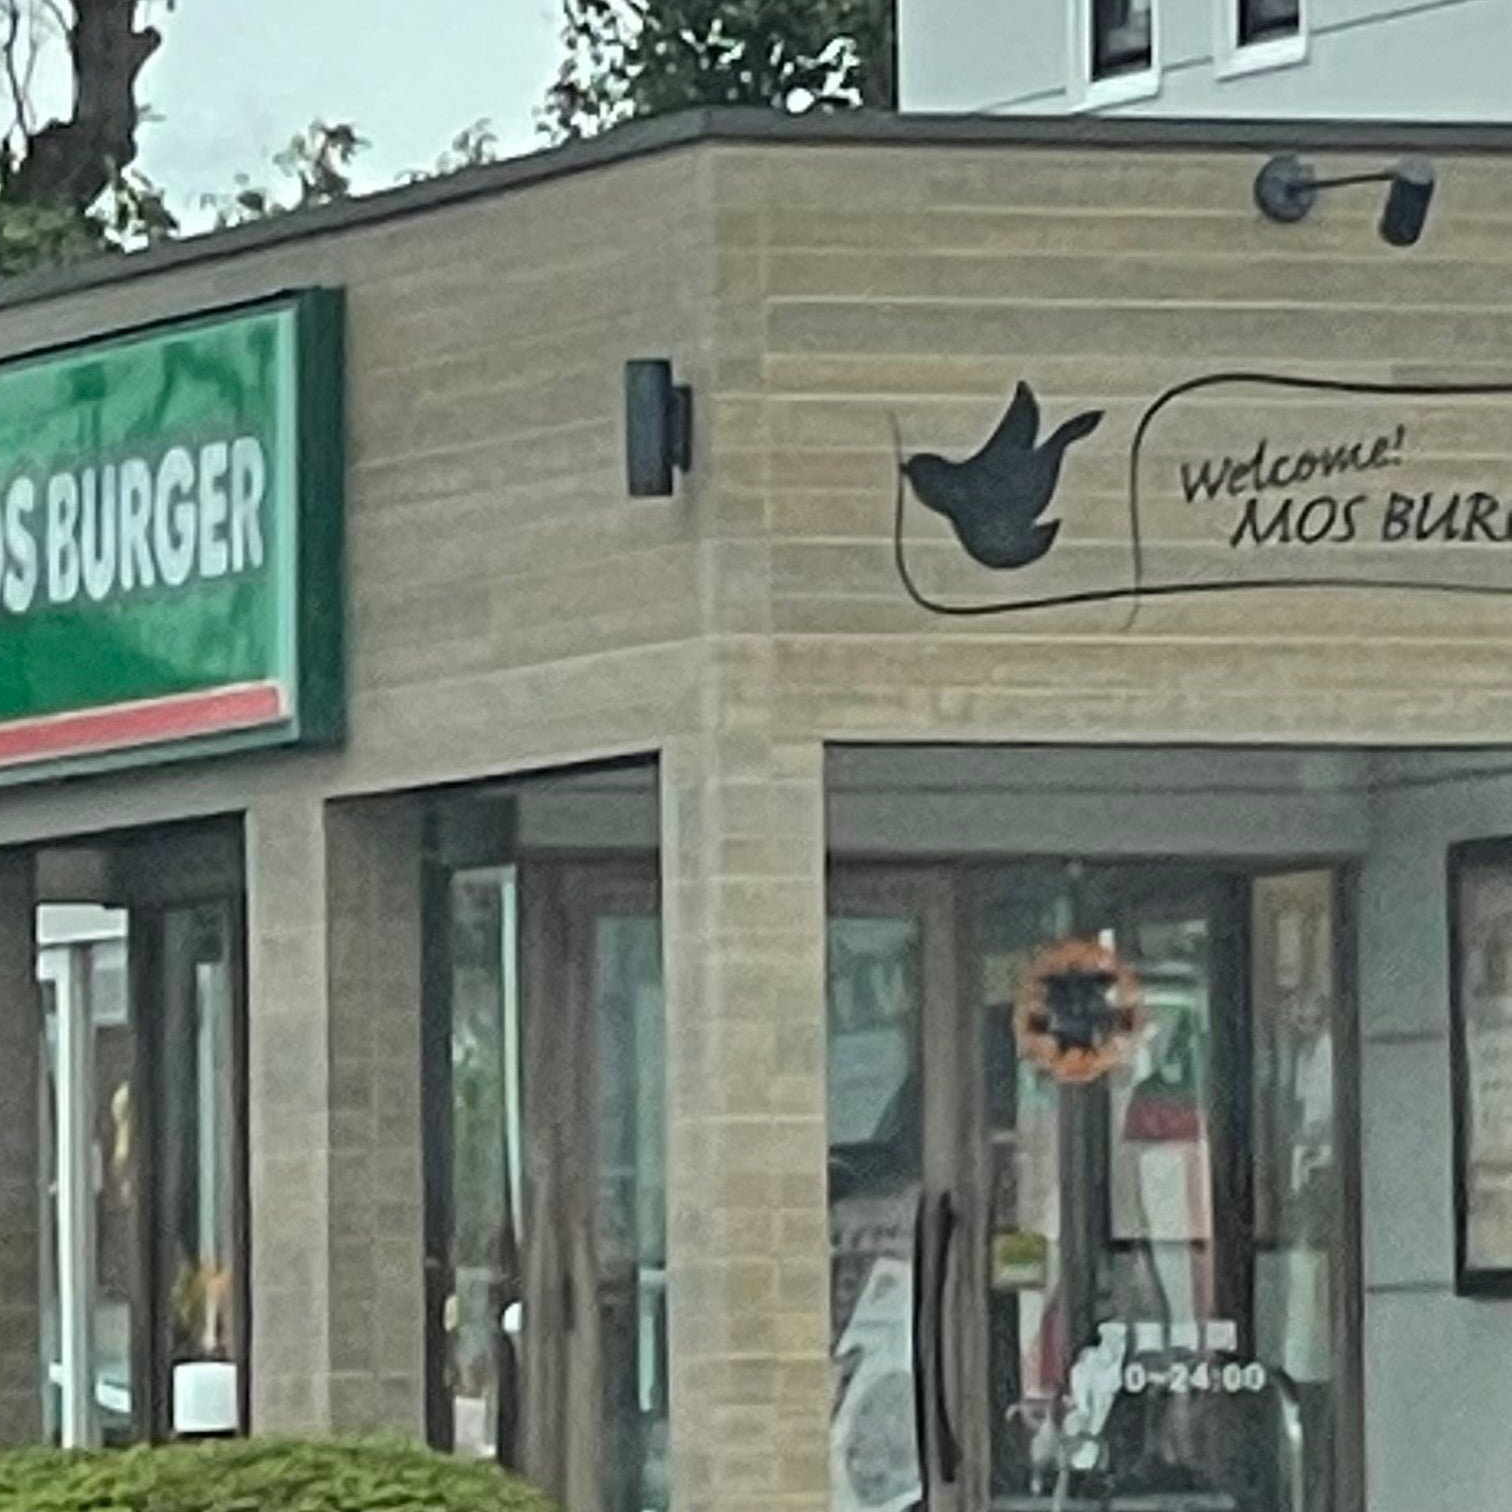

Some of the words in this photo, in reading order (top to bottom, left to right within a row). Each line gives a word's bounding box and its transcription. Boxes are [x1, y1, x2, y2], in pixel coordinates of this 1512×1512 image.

[1181, 424, 1406, 503] Welcome!
[46, 437, 264, 602] BURGER
[1229, 495, 1368, 549] MOS
[1381, 490, 1512, 543] BUR
